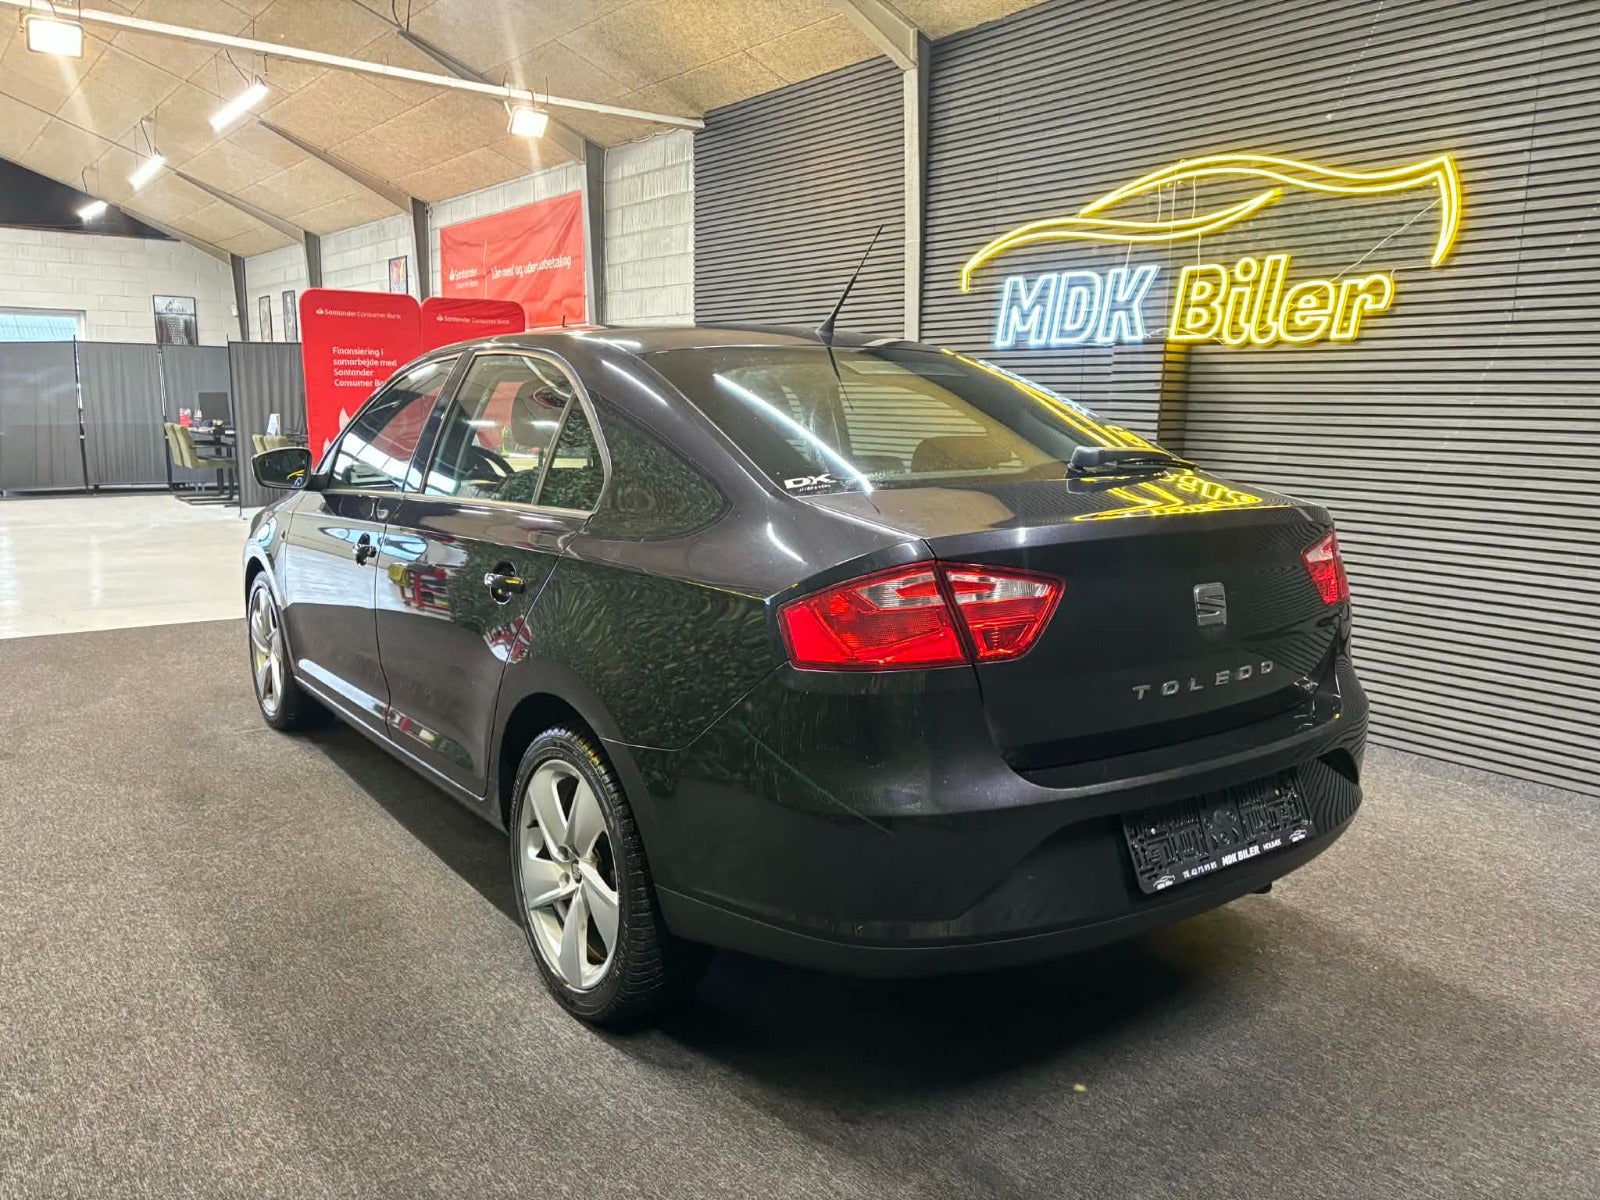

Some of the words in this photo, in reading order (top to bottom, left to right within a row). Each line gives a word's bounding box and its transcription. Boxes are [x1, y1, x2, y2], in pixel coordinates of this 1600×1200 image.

[514, 264, 524, 279] og
[995, 264, 1161, 348] MDK
[1169, 253, 1395, 346] Biler
[324, 308, 357, 318] Santander
[357, 310, 386, 319] Consumer
[332, 346, 380, 357] Finansiering
[333, 358, 379, 368] samarbejde
[380, 359, 397, 367] med
[333, 368, 374, 377] Santander
[334, 379, 373, 387] Consumer
[1132, 660, 1274, 700] TOLEDO
[1221, 852, 1238, 867] MDK
[1237, 845, 1260, 861] BILER
